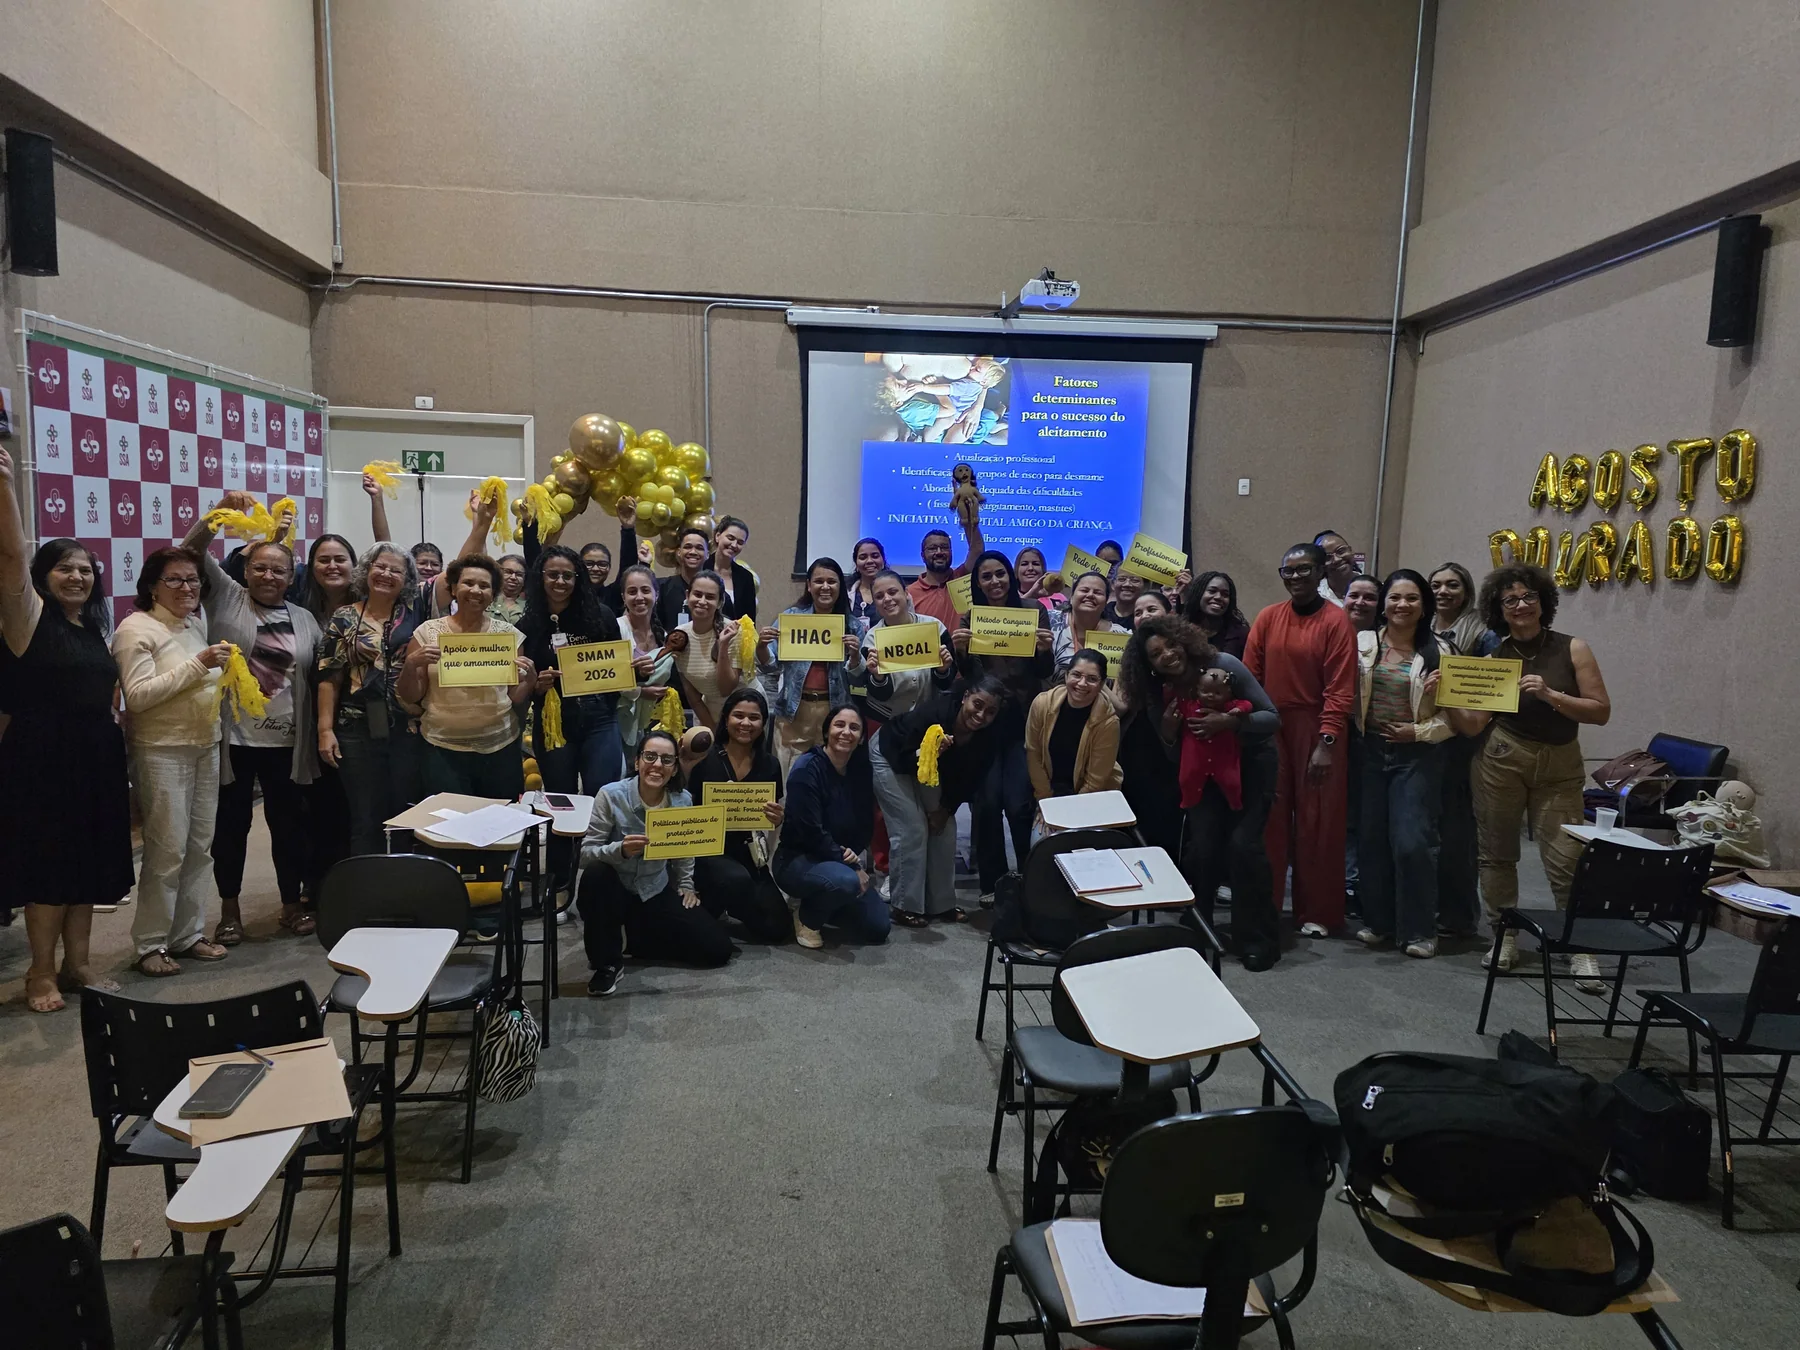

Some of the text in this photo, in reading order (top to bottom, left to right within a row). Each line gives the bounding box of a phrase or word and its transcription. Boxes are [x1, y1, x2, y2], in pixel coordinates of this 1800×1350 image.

[1053, 375, 1098, 388] Fatores
[82, 386, 93, 401] SSA
[1032, 392, 1117, 405] determinantes
[148, 401, 158, 414] SSA
[205, 413, 214, 425] SSA
[1021, 411, 1126, 422] para o sucesso do
[1038, 426, 1107, 438] aleitamento
[47, 444, 59, 459] SSA
[953, 452, 1056, 464] Atualização profissional
[119, 453, 129, 467] SSA
[179, 461, 189, 473] SSA
[1528, 428, 1756, 512] AGOSTO
[977, 470, 1007, 481] grupos
[1009, 470, 1020, 479] de
[1021, 469, 1042, 479] risco
[1044, 472, 1062, 482] para
[1064, 472, 1104, 481] desmame
[979, 485, 1014, 496] dequada
[1016, 486, 1031, 495] das
[1033, 486, 1083, 497] dificuldades
[1038, 503, 1076, 514] mastites)
[87, 510, 99, 524] SSA
[152, 513, 162, 526] SSA
[888, 513, 949, 524] INICIATIVA
[1008, 518, 1046, 528] AMIGO
[1048, 519, 1064, 528] DA
[1066, 520, 1113, 531] CRIANÇA
[999, 535, 1013, 543] em
[1014, 535, 1043, 546] equipe
[1134, 541, 1182, 567] Profissionais
[1072, 552, 1101, 573] Rede de
[1130, 556, 1176, 577] capacitados
[123, 568, 134, 582] SSA
[976, 616, 1033, 627] Método Canguru
[790, 628, 831, 645] IHAC
[983, 628, 1008, 636] contato
[1009, 630, 1023, 638] pele
[443, 644, 511, 656] Apoio à mulher
[576, 649, 616, 663] SMAM
[884, 642, 932, 658] NBCAL
[443, 659, 511, 669] que amamenta
[584, 667, 616, 681] 2026
[652, 815, 719, 827] Políticas públicas de
[666, 828, 694, 838] proteção
